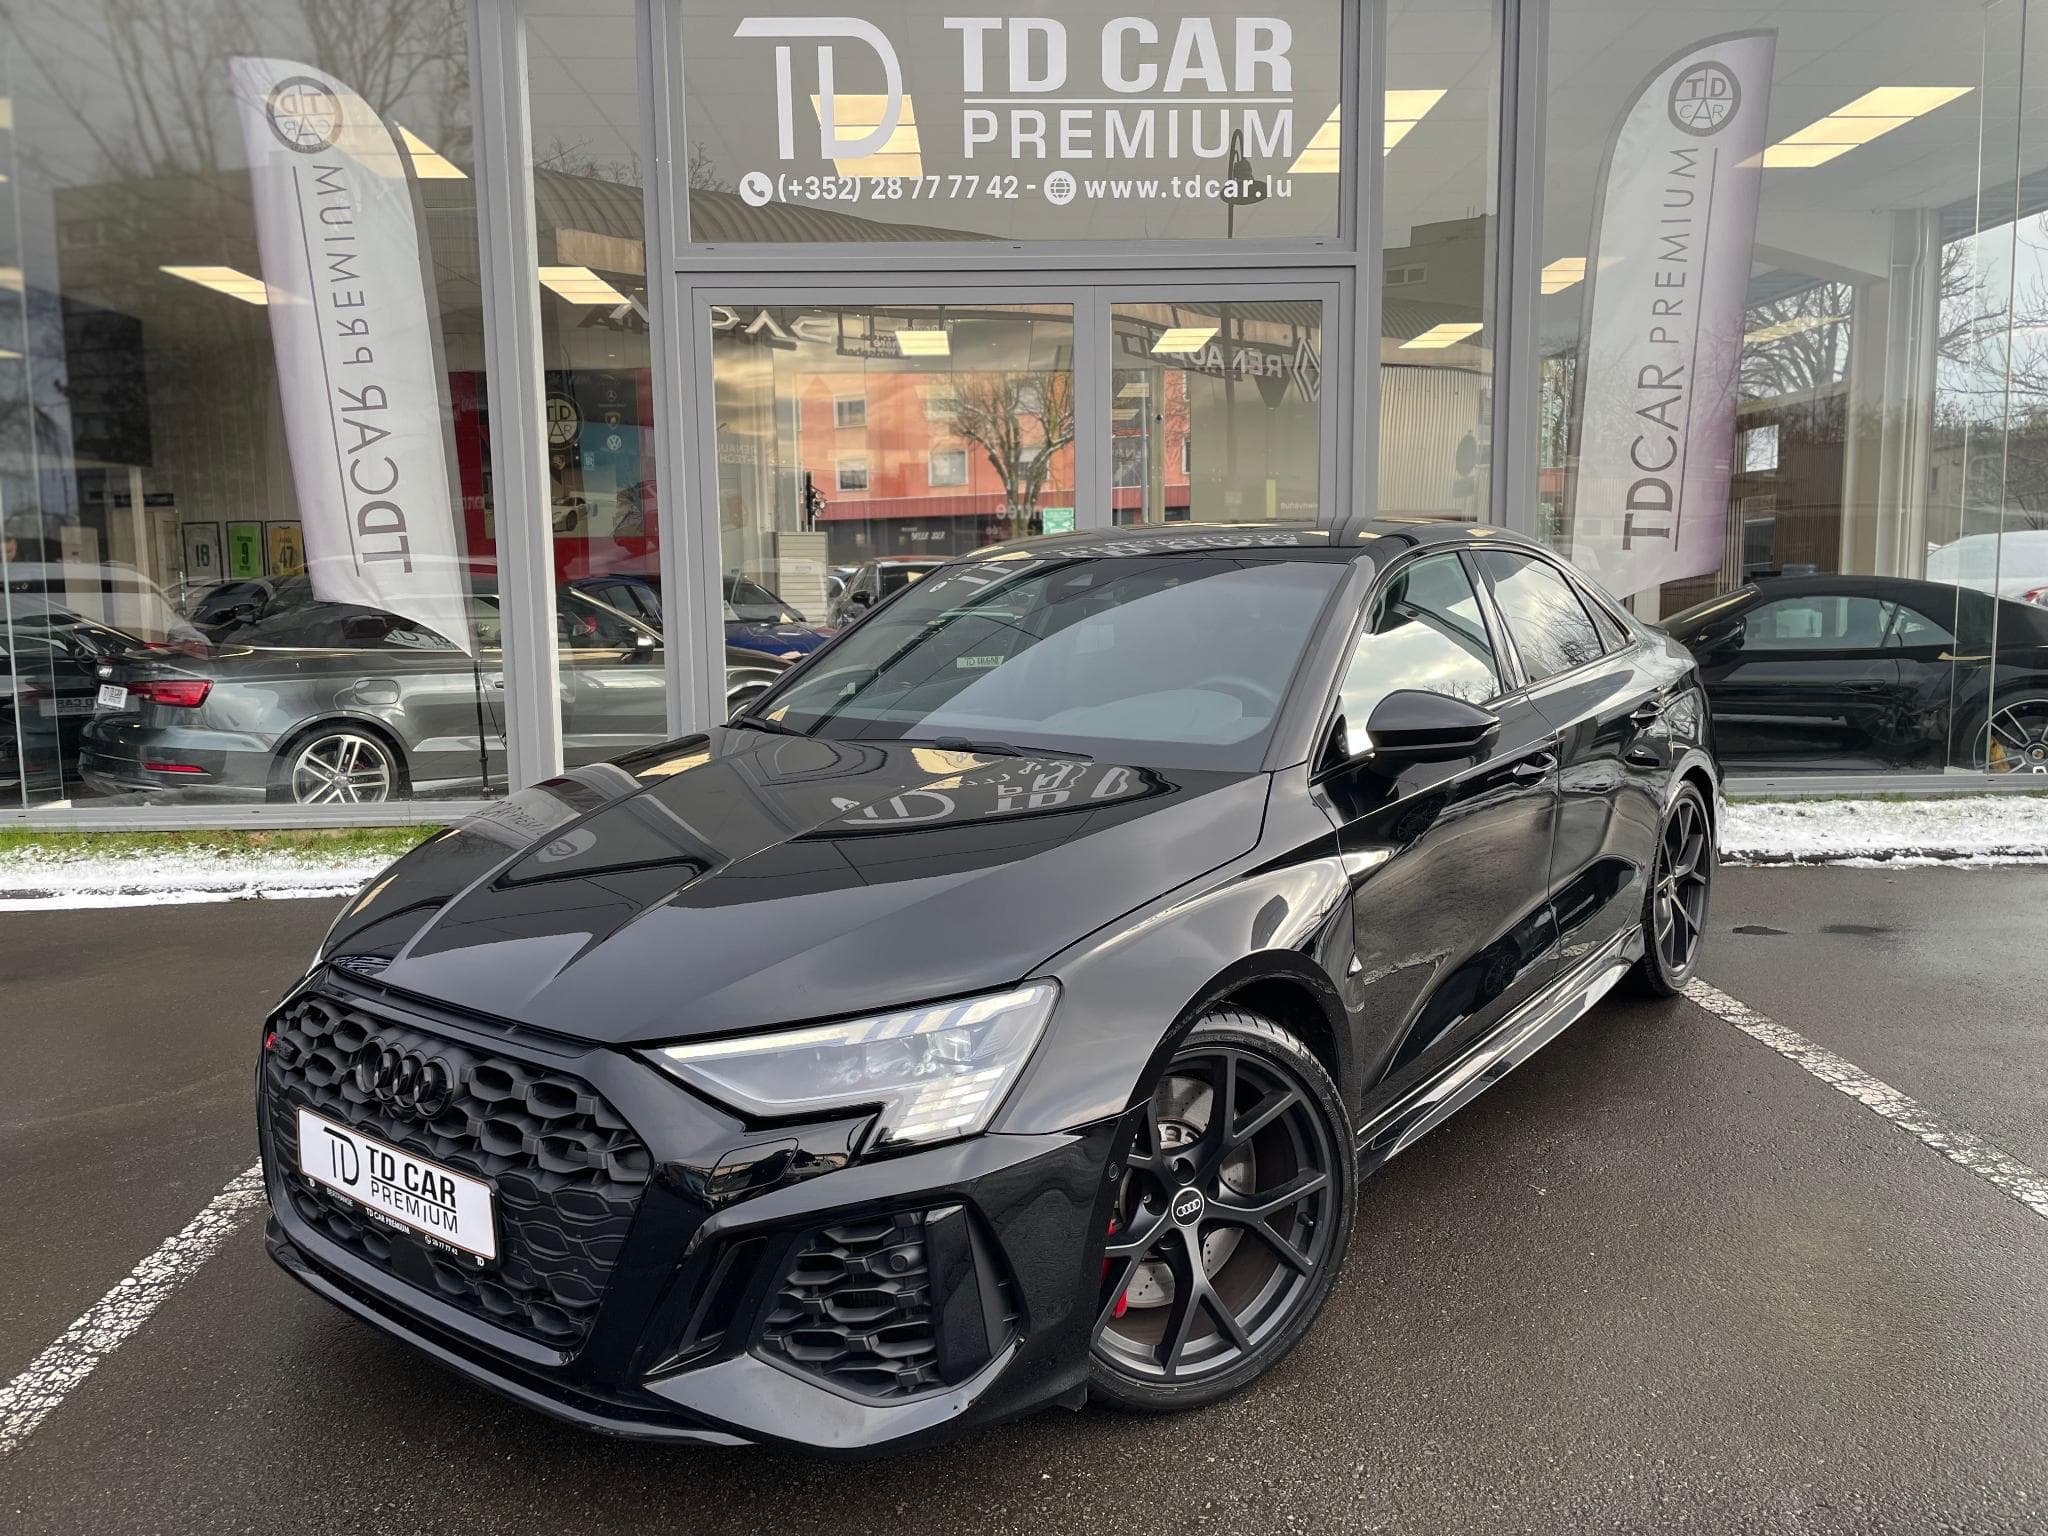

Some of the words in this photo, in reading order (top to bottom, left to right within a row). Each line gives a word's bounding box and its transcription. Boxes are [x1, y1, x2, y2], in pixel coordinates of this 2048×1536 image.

[944, 17, 1067, 92] TD
[1101, 17, 1293, 92] CAR
[964, 109, 1293, 158] PREMIUM
[777, 175, 861, 203] (+352)
[871, 176, 903, 200] 28
[909, 176, 941, 200] 77
[948, 176, 980, 200] 77
[986, 176, 1020, 200] 42
[1085, 175, 1293, 200] www.tdcar.lu
[1649, 147, 1699, 344] PREMIUM
[1622, 364, 1685, 551] TDCAR
[366, 1145, 395, 1182] TD
[404, 1162, 456, 1208] CAR
[371, 1180, 458, 1234] PREMIUM
